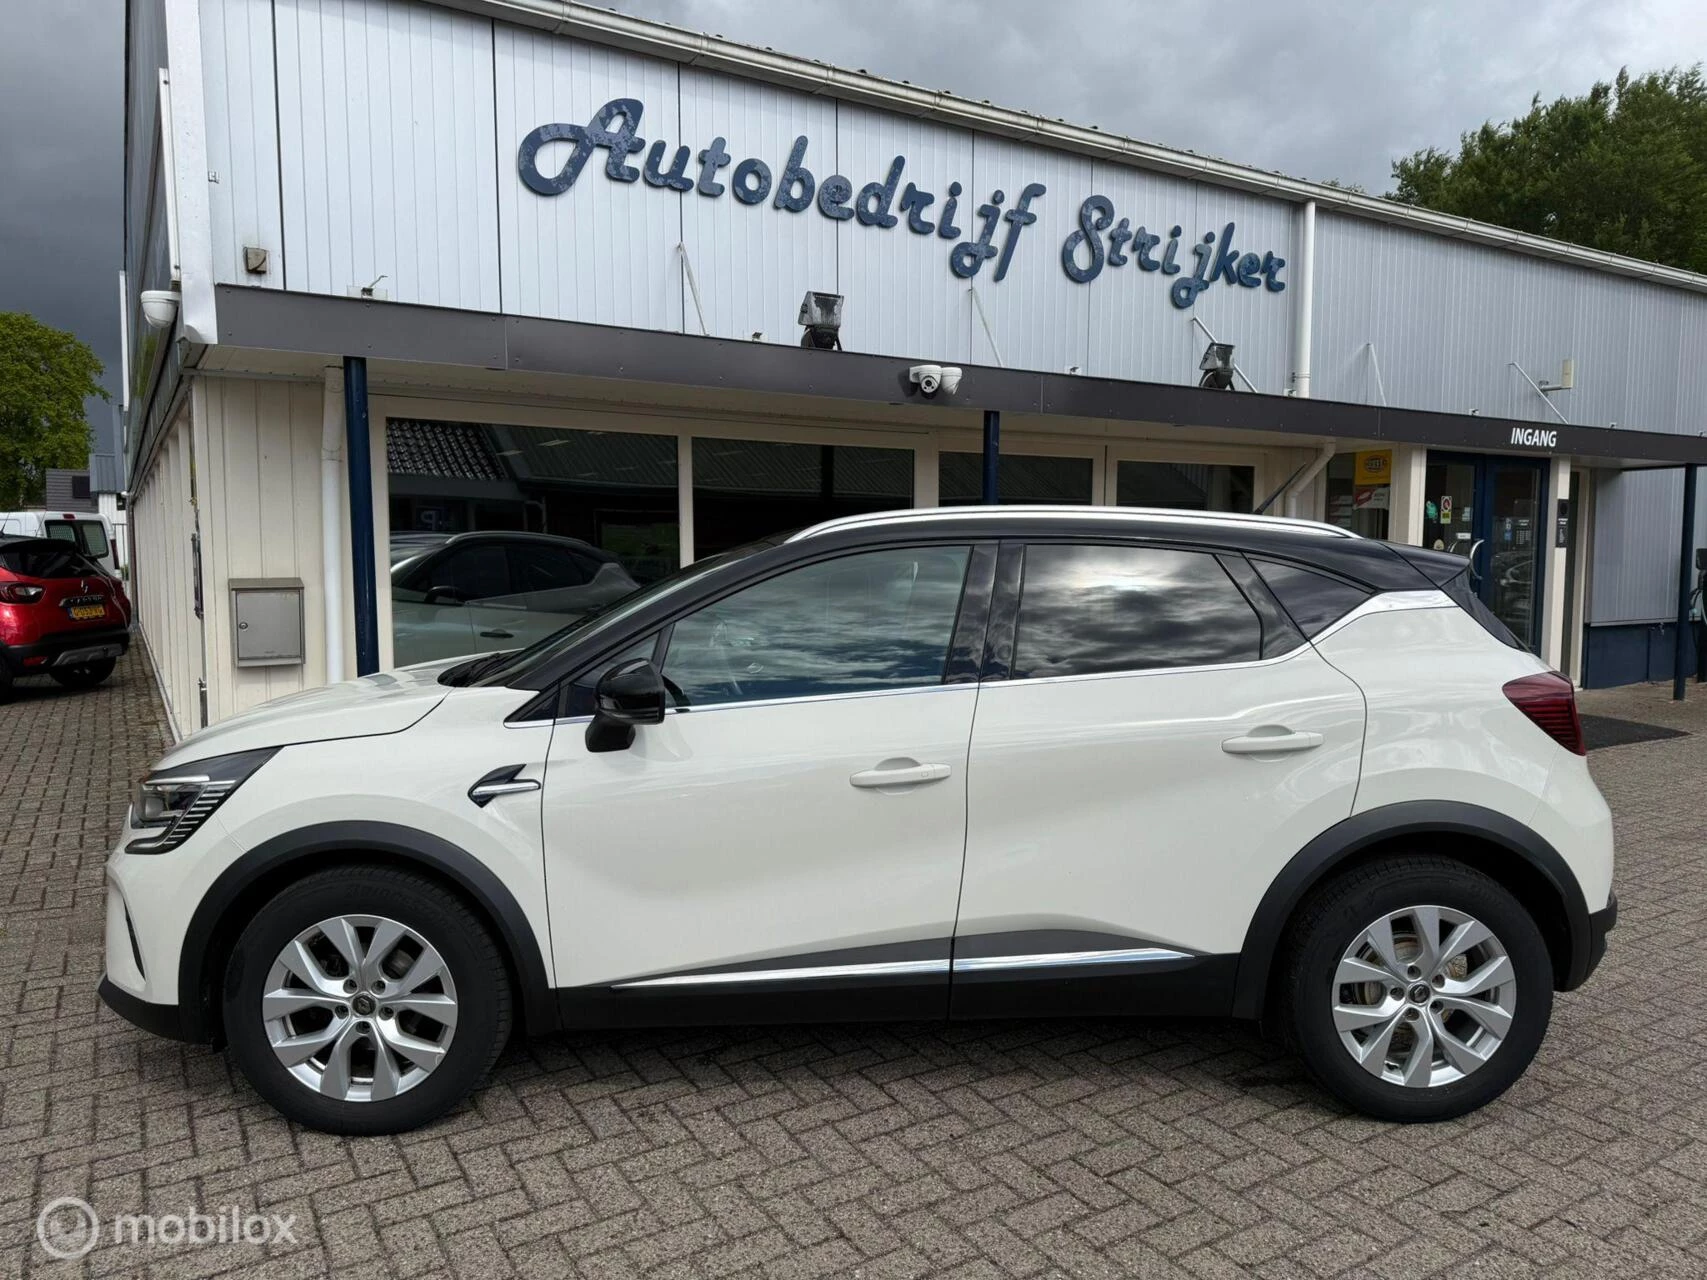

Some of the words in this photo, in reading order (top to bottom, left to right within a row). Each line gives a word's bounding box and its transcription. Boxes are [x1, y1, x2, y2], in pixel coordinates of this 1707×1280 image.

[517, 97, 1046, 283] Autobedrijf
[1062, 194, 1287, 309] Strijker
[1510, 427, 1557, 447] INGANG
